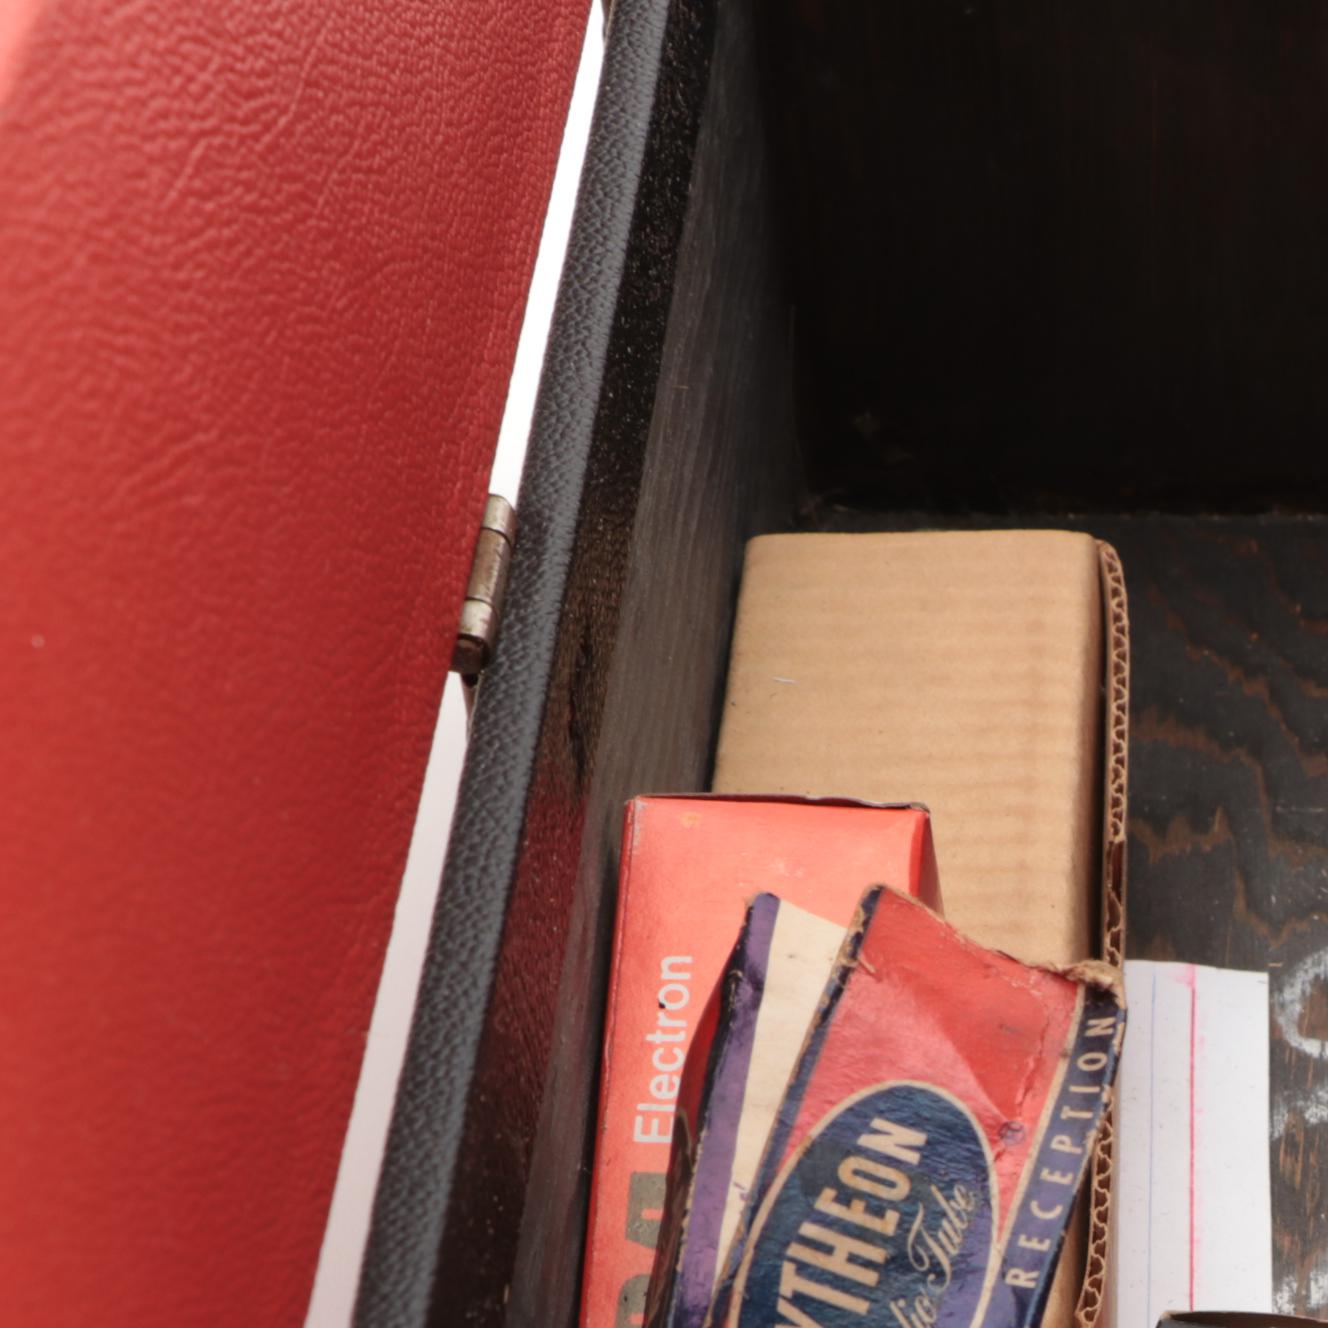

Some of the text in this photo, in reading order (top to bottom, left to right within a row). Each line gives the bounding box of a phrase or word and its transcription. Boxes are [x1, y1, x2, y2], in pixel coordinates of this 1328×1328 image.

[633, 954, 693, 1144] Electron
[907, 1184, 977, 1292] Tube
[1005, 1016, 1117, 1289] RECEPTION
